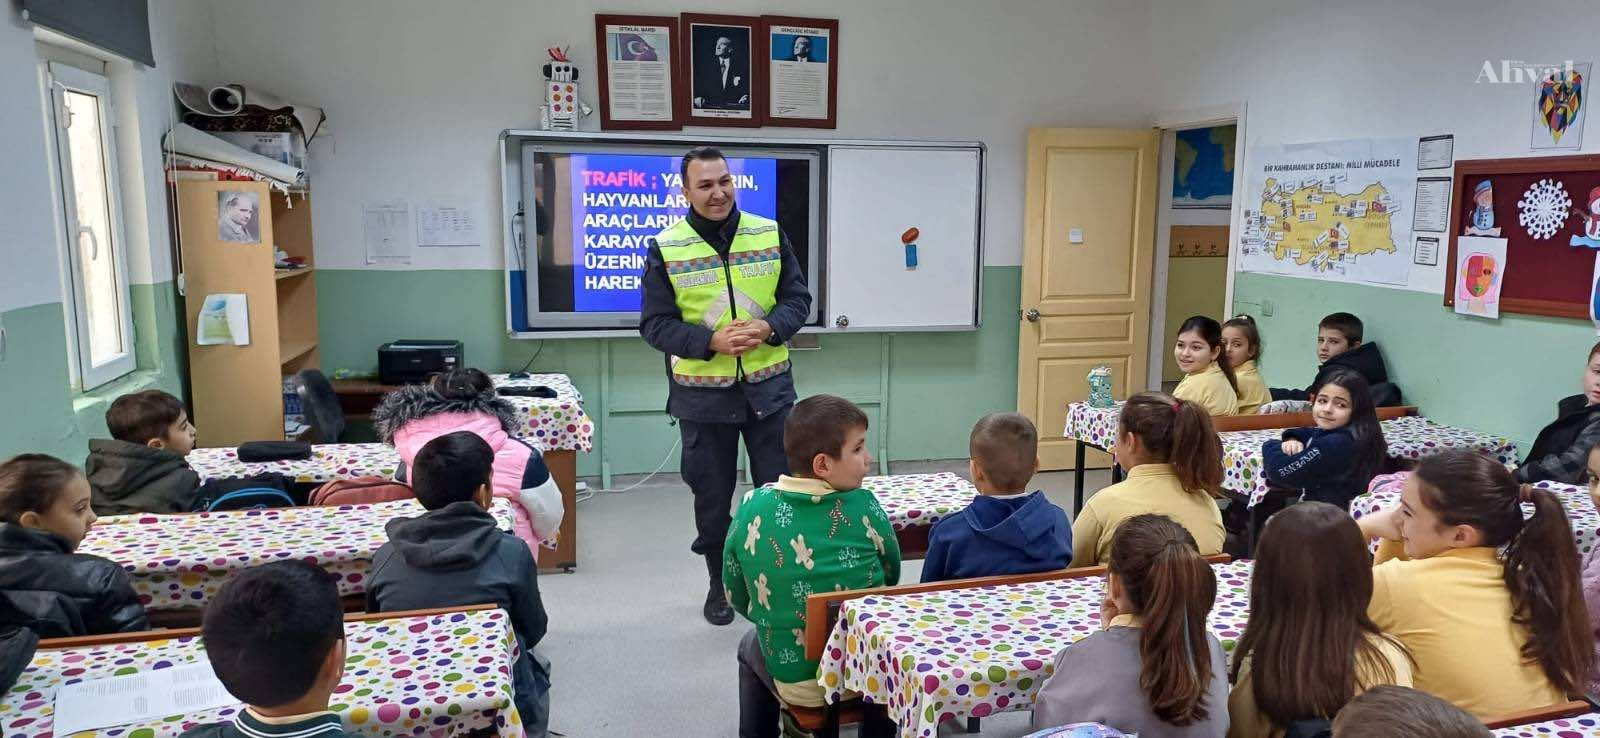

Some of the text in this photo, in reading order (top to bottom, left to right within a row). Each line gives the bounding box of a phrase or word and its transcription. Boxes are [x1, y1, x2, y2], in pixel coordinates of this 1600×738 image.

[581, 170, 647, 187] TRAFİK
[582, 192, 691, 208] HAYVANLAR
[1278, 448, 1321, 477] SUSPENSE
